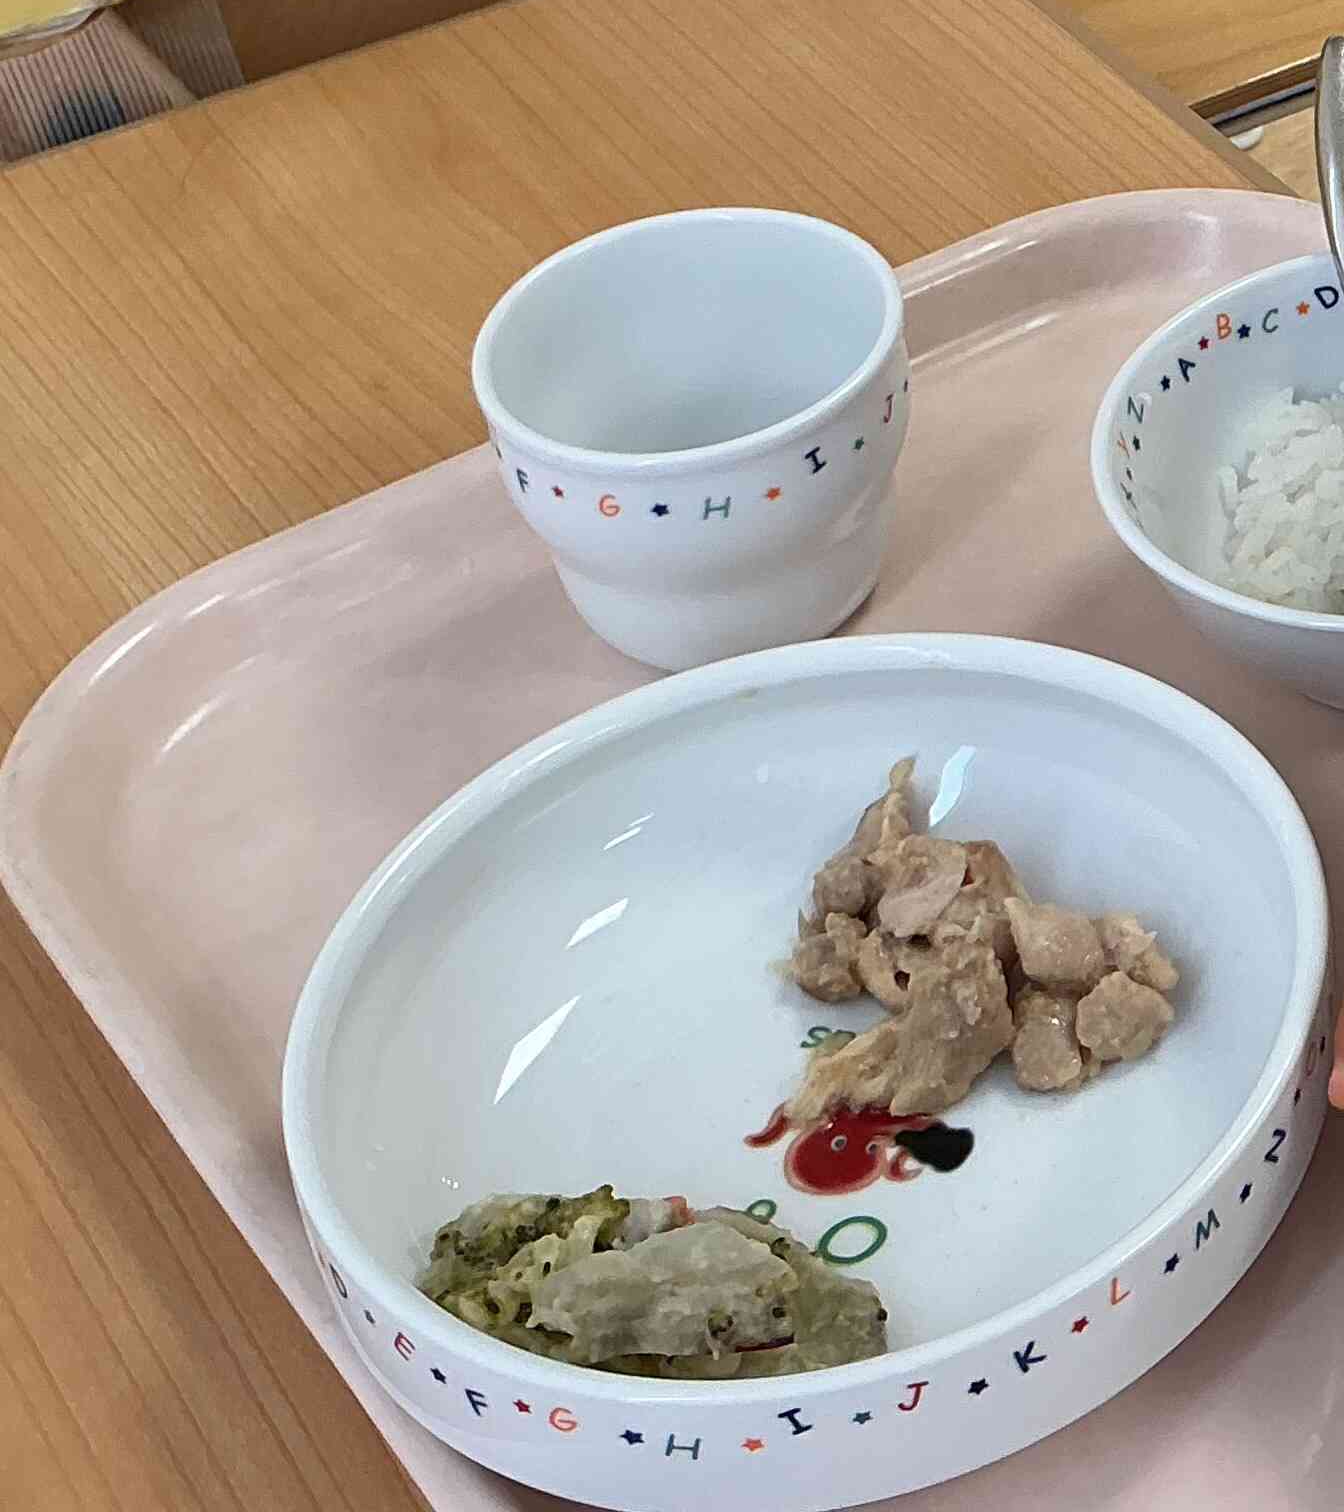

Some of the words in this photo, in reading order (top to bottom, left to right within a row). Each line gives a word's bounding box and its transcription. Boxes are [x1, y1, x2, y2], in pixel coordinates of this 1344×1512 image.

[1177, 357, 1197, 383] A
[1215, 313, 1233, 340] B
[1261, 307, 1279, 334] C
[1313, 285, 1340, 310] D
[515, 467, 529, 494] F
[598, 493, 621, 518] G
[702, 495, 732, 521] H
[804, 446, 827, 475] I
[882, 393, 895, 424] J
[393, 1331, 416, 1362] E
[464, 1388, 488, 1417] F
[548, 1407, 578, 1433] G
[664, 1433, 702, 1462] H
[777, 1407, 814, 1437] I
[897, 1380, 930, 1412] J
[1013, 1340, 1047, 1374] K
[1110, 1276, 1131, 1306] L
[1195, 1208, 1221, 1251] M
